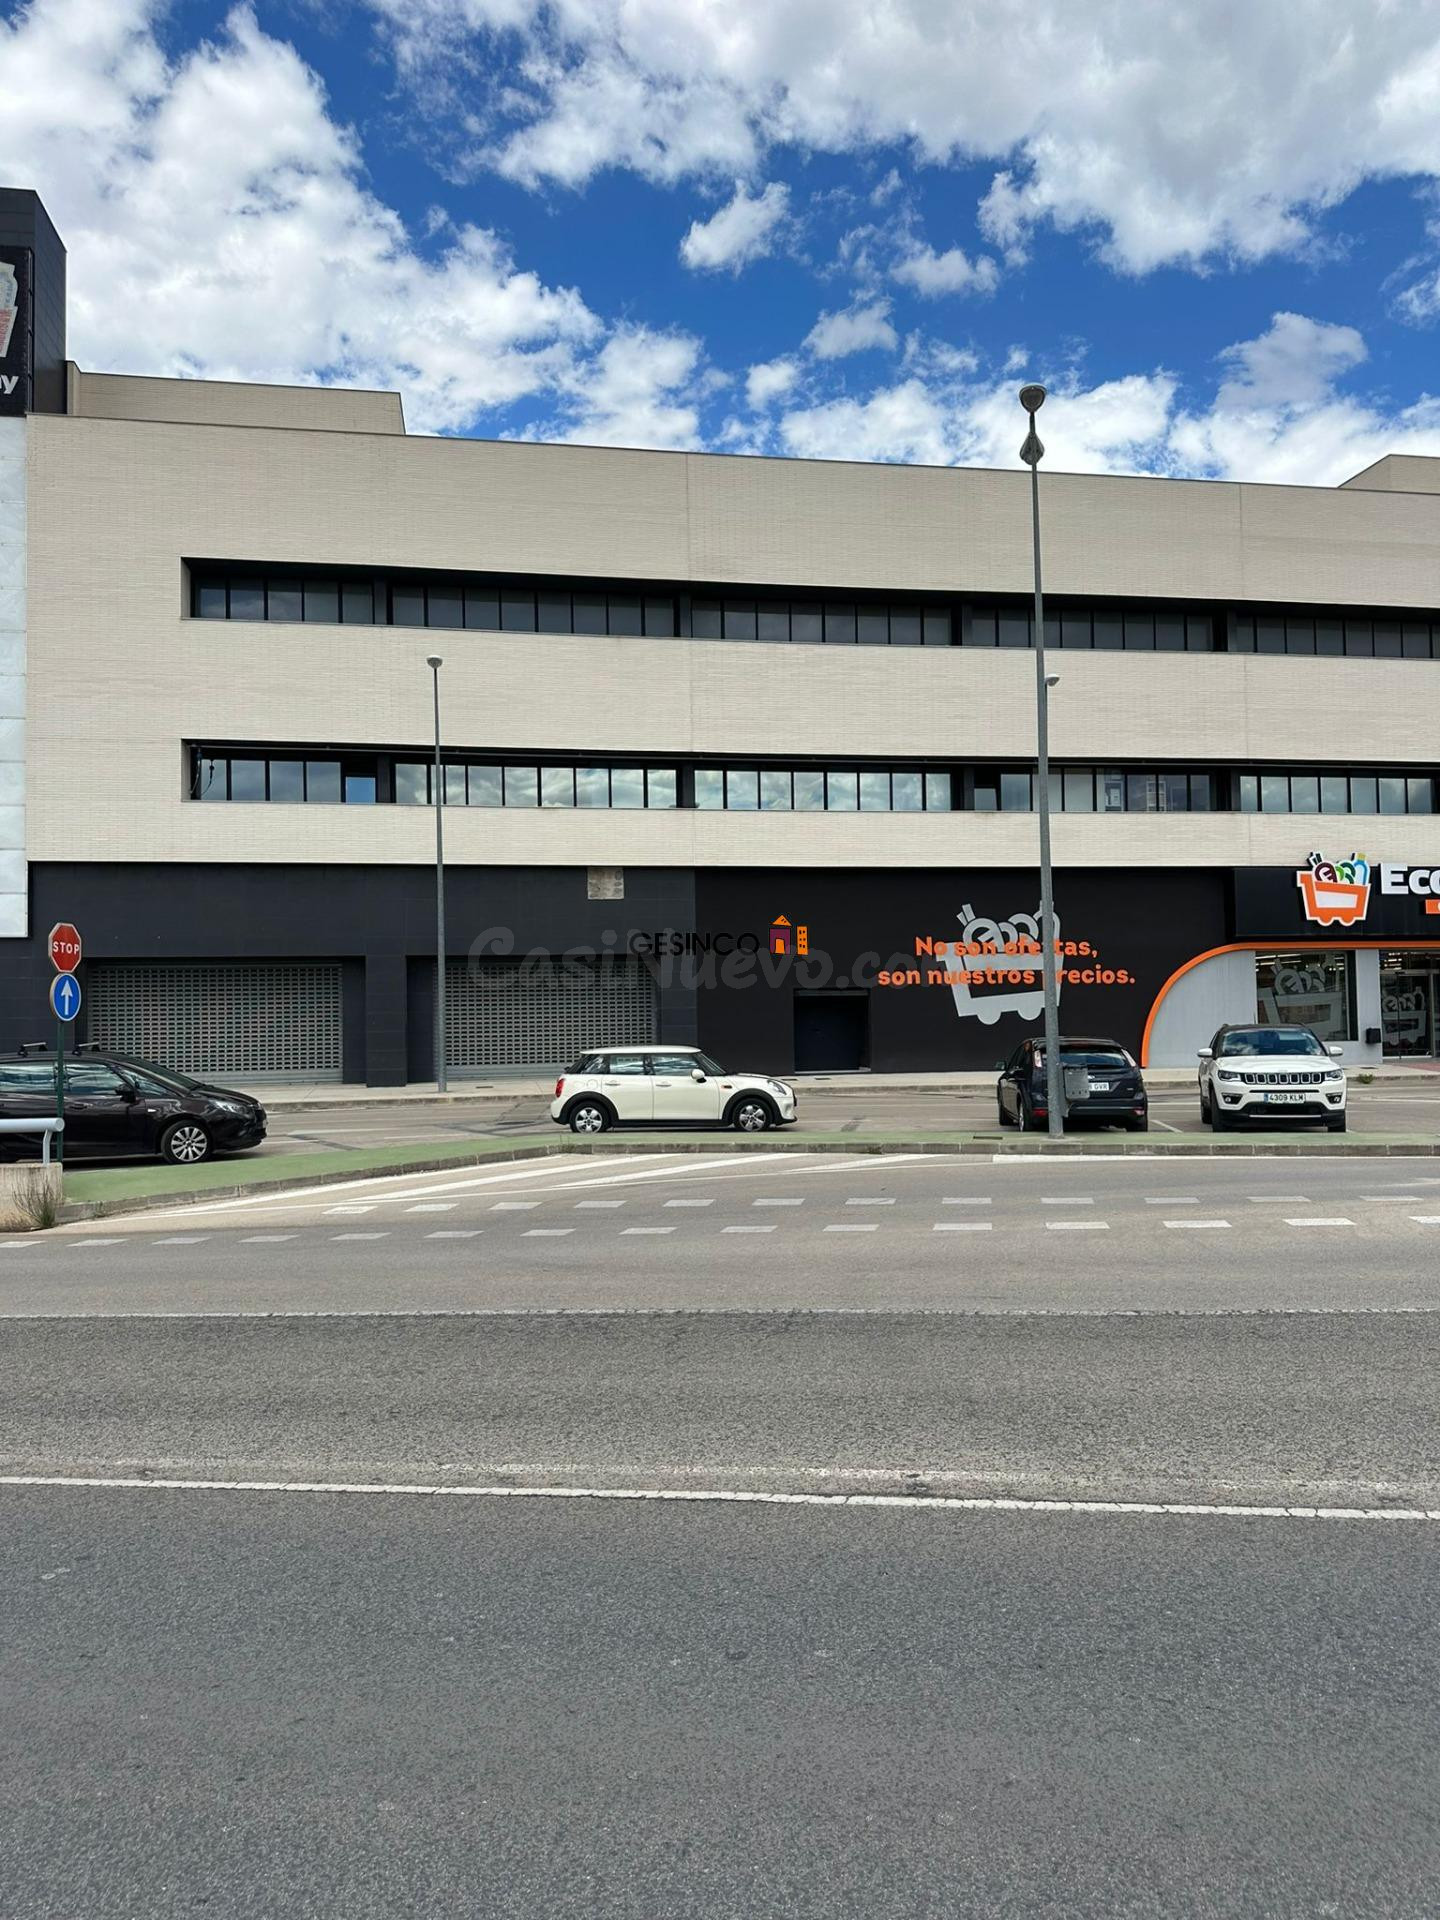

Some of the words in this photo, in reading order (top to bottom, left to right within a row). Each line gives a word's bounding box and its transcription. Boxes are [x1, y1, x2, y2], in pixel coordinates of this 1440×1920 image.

[0, 375, 19, 394] y
[52, 941, 80, 954] STOP
[915, 936, 948, 956] No
[954, 941, 997, 957] son
[1003, 936, 1098, 959] ofetas,
[877, 969, 921, 986] son
[927, 966, 1036, 986] nuestros
[1042, 963, 1136, 989] recios.
